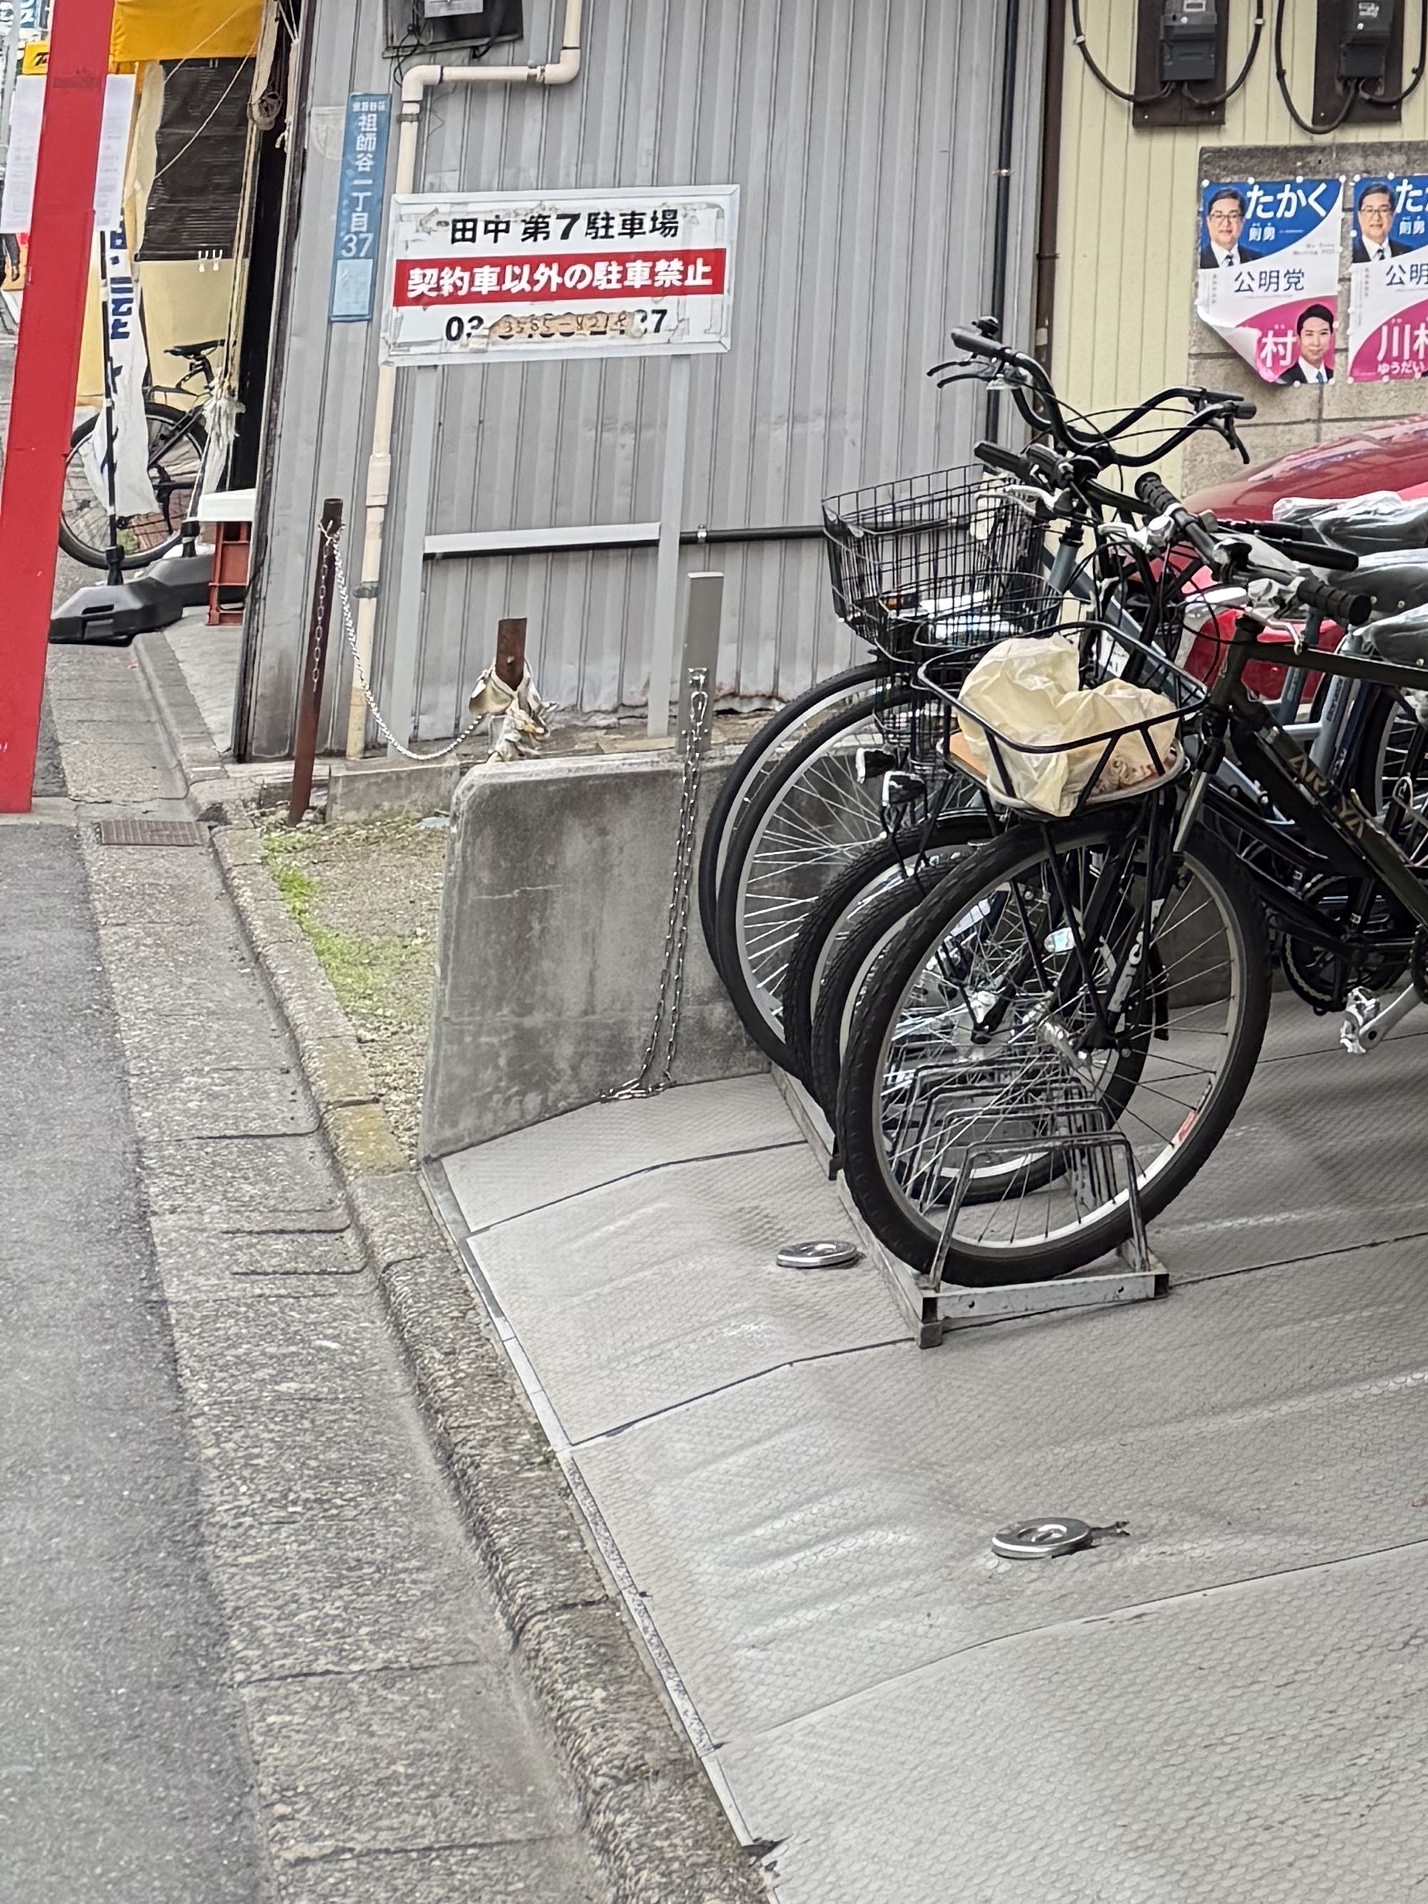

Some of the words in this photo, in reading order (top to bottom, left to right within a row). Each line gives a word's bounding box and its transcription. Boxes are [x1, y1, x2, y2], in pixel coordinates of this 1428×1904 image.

[350, 113, 378, 233] 祖師谷一丁目
[1246, 182, 1328, 219] たかく
[341, 233, 374, 258] 37
[407, 257, 713, 297] 契約車以外の駐車禁止
[1234, 268, 1305, 293] 公明党
[1378, 360, 1425, 376] ゆうだい
